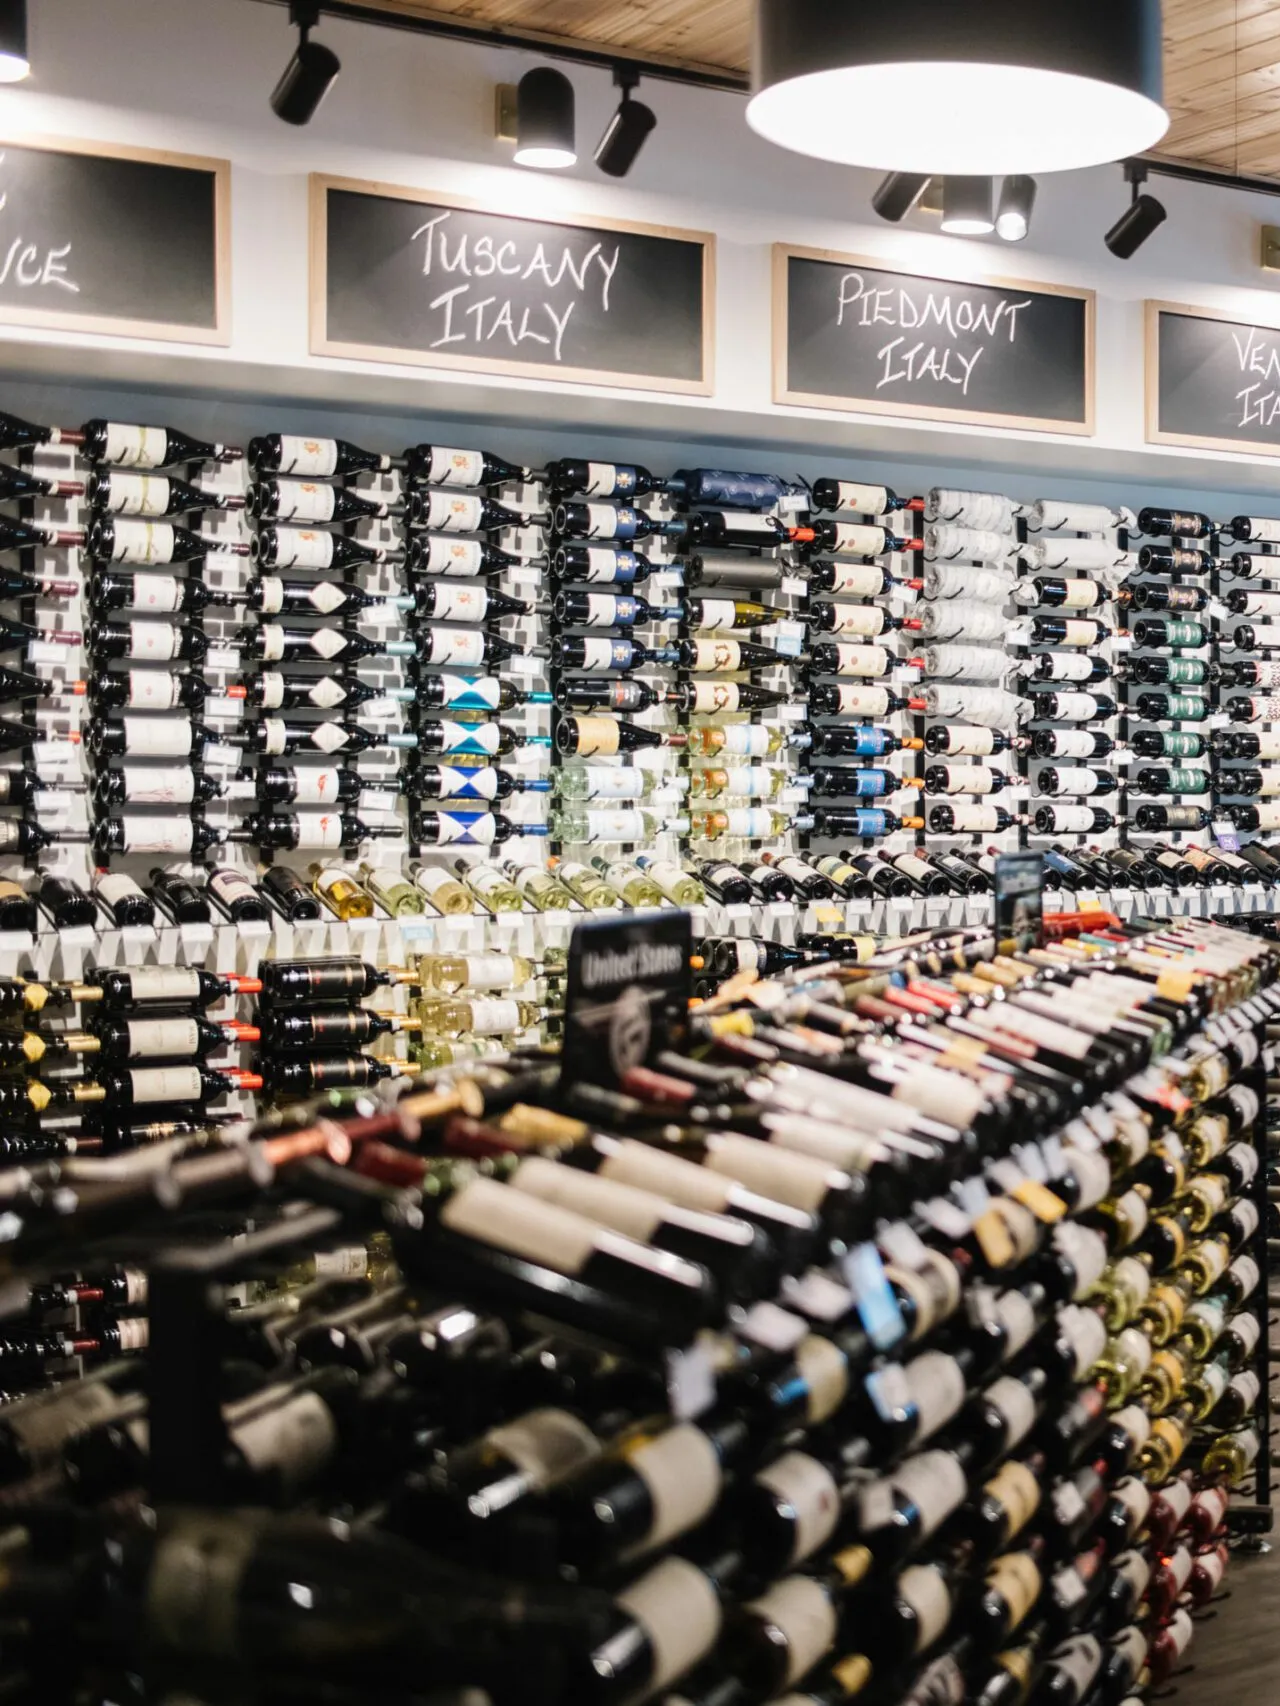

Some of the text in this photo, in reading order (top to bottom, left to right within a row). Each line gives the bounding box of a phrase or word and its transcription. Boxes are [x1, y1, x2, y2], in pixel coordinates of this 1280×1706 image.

[411, 211, 620, 312] TUSCANY
[429, 283, 576, 361] ITALY
[837, 272, 1032, 342] PIEDMONT
[876, 336, 984, 395] ITALY
[581, 943, 683, 988] United States
